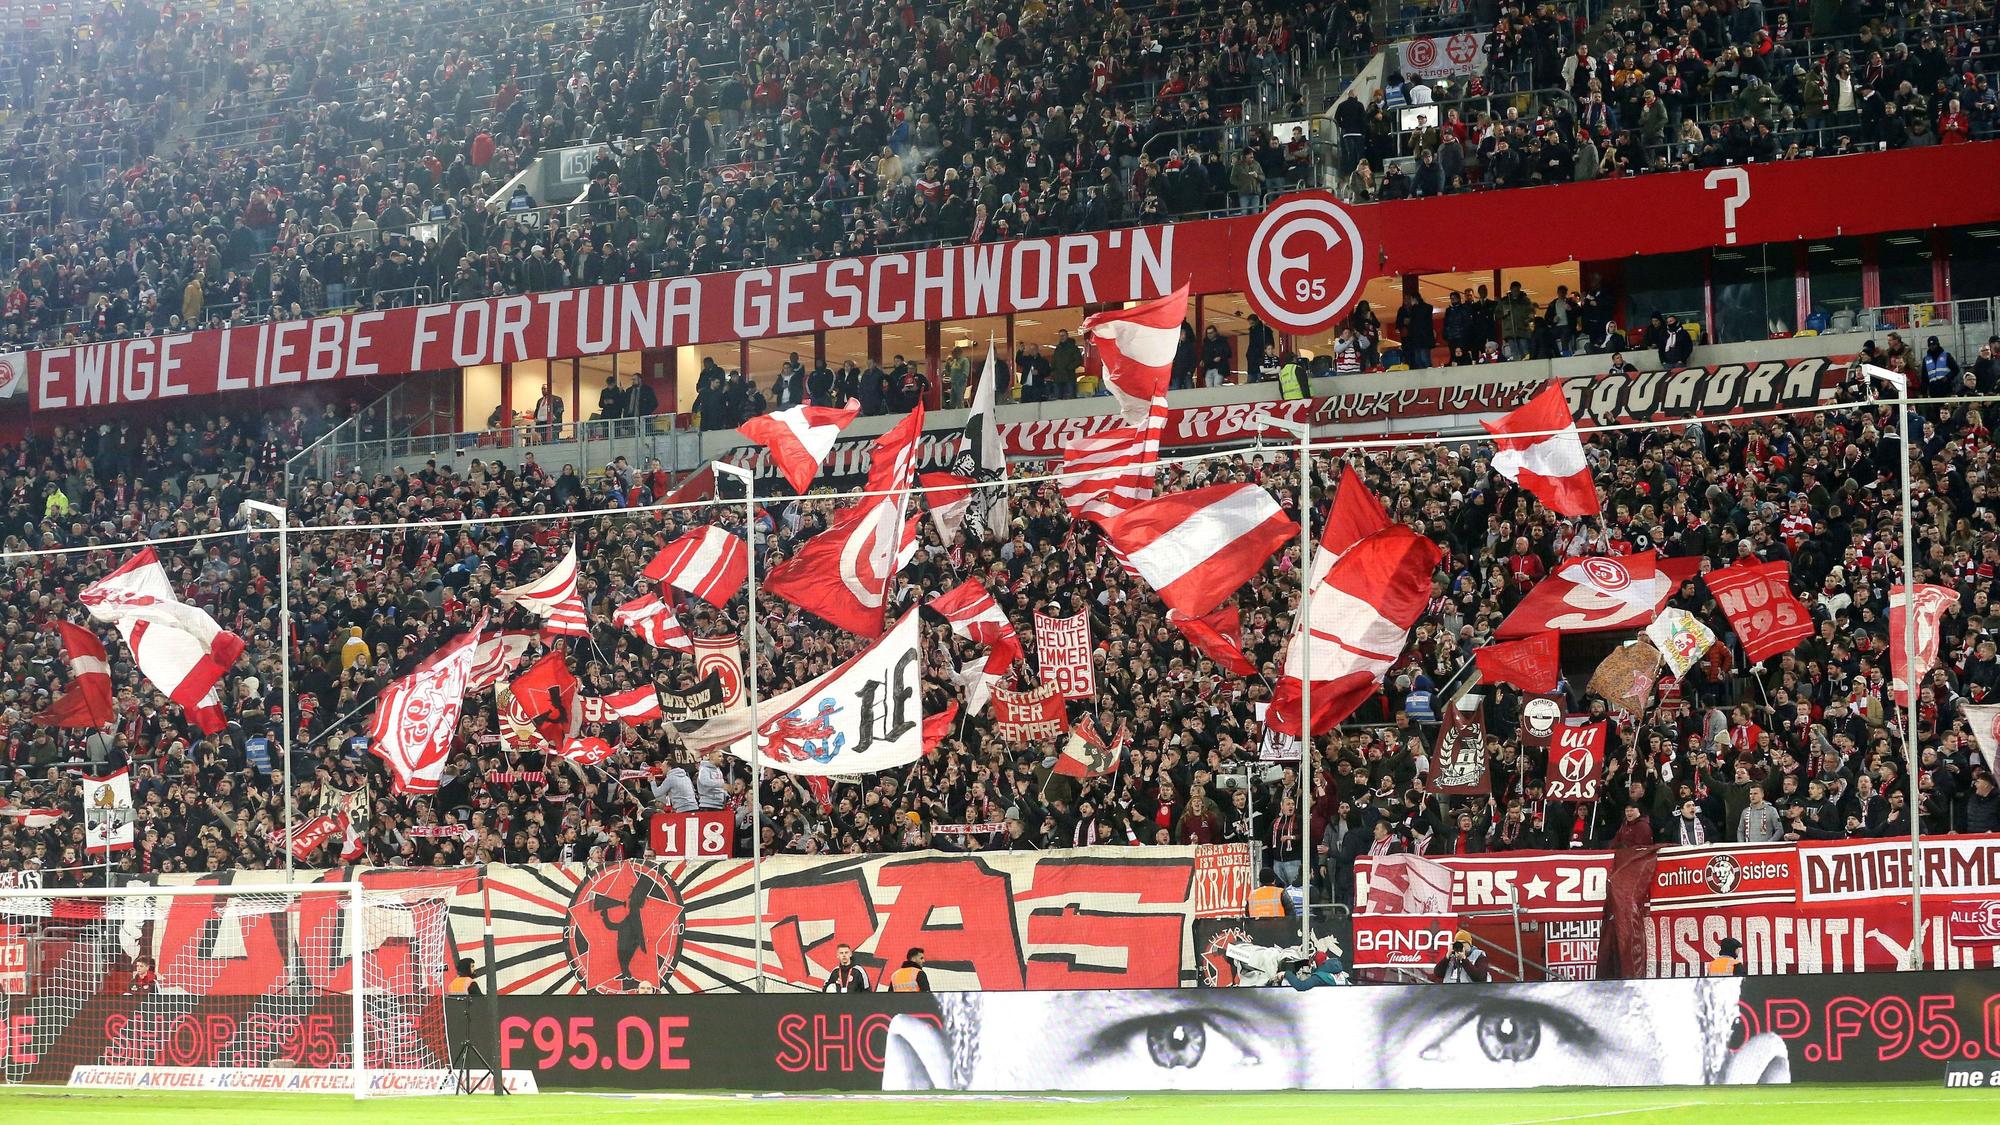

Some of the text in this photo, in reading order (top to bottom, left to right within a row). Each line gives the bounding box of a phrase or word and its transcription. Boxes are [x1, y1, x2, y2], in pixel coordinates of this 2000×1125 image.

[1295, 278, 1326, 302] 95
[39, 225, 1174, 409] EWIGE LIEBE FORTUNA GESCHWOR'N
[1561, 356, 1829, 425] SQUADRA
[1180, 399, 1312, 438] WEST
[1036, 613, 1086, 631] DAMALS
[1733, 603, 1798, 643] F95
[1037, 629, 1087, 648] HEUTE
[1040, 647, 1089, 666] IMMER
[660, 688, 711, 709] WIR SIND
[1007, 703, 1044, 722] PER
[997, 719, 1063, 742] SEMPRE
[1559, 727, 1599, 748] ULT
[1546, 779, 1598, 799] RAS
[1657, 861, 1789, 887] antira sisters
[768, 857, 1195, 990] RAS
[1951, 911, 1987, 923] ALLES
[1356, 929, 1456, 951] BANDA
[500, 1015, 690, 1071] F95.DE
[775, 1013, 941, 1072] SHO
[73, 1070, 137, 1086] KÜCHEN
[138, 1071, 205, 1087] AKTUELL
[1947, 1069, 1983, 1087] me
